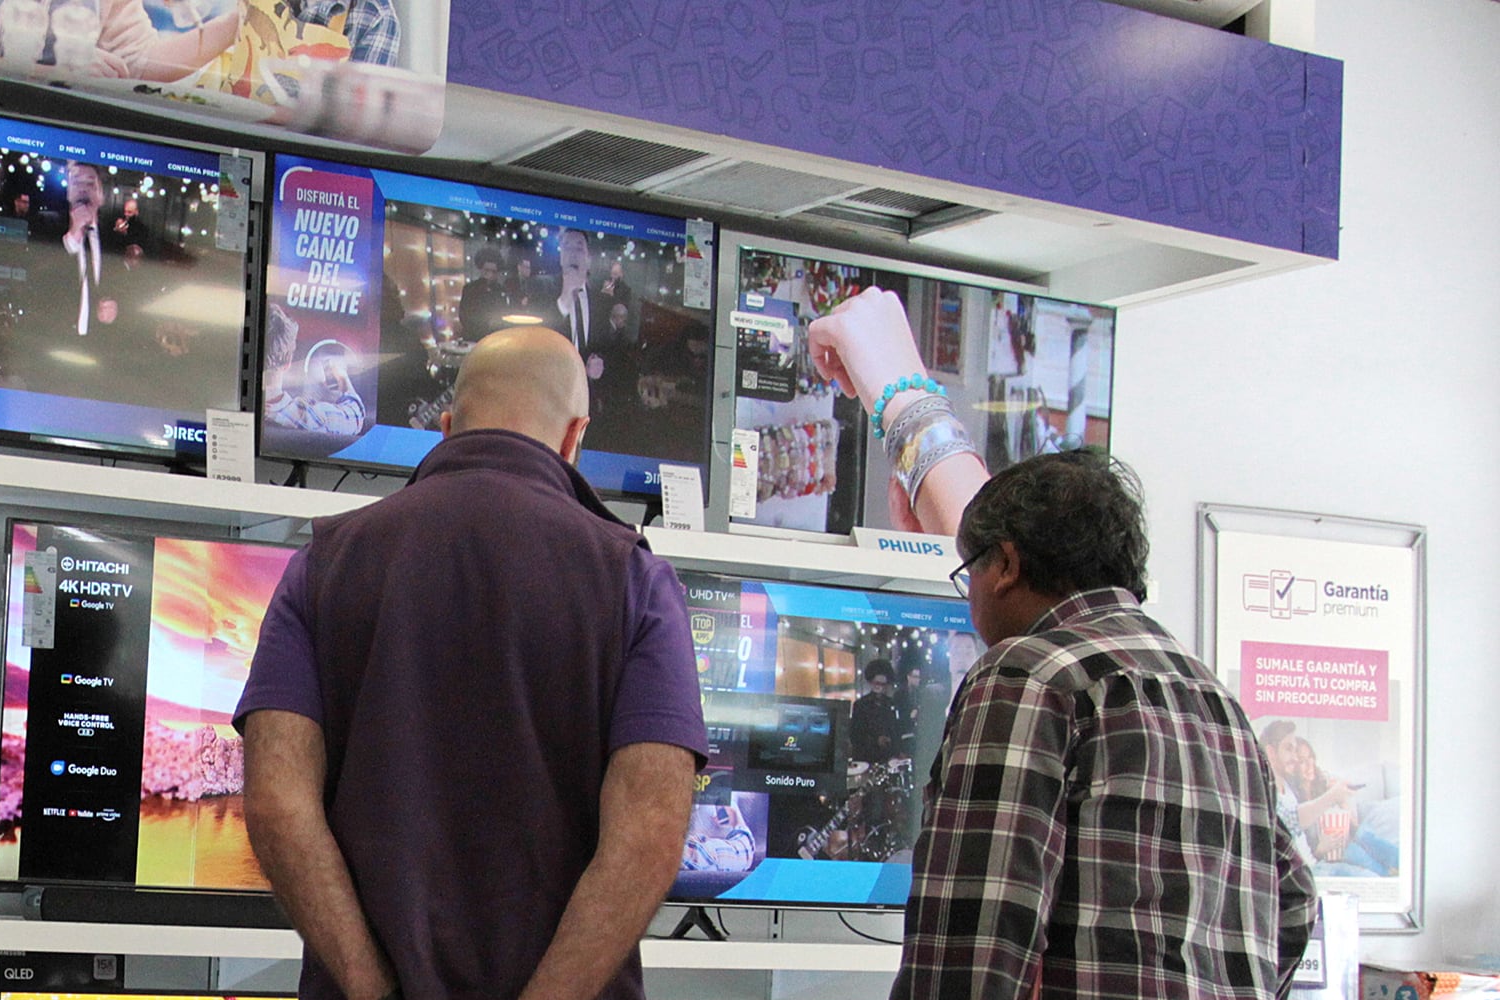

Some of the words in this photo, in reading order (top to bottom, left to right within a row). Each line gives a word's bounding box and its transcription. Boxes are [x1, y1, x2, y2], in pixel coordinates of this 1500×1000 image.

[66, 145, 86, 156] NEWS
[107, 153, 133, 164] SPORTS
[134, 157, 154, 168] FIGHT
[167, 163, 202, 176] CONTRATA
[203, 168, 220, 178] PREM
[296, 187, 345, 209] DISFRUTÁ
[348, 196, 360, 210] EL
[293, 208, 360, 240] NUEVO
[296, 234, 355, 264] CANAL
[307, 260, 340, 287] DEL
[287, 282, 362, 315] CLIENTE
[163, 424, 208, 444] DIRECT
[878, 538, 944, 556] PHILIPS
[75, 559, 130, 575] HITACHI
[58, 579, 79, 594] 4K
[80, 580, 111, 596] HDR
[111, 583, 133, 598] TV
[688, 589, 714, 600] UHD
[714, 590, 728, 601] TV
[1324, 581, 1389, 601] Garantía
[81, 599, 105, 611] Google
[105, 602, 115, 610] TV
[1323, 602, 1379, 618] premium
[695, 618, 712, 629] TOP
[740, 614, 754, 630] EL
[1255, 657, 1304, 672] SUMALE
[1306, 660, 1366, 676] GARANTÍA
[1369, 664, 1378, 677] Y
[74, 675, 102, 688] Google
[103, 677, 114, 687] TV
[1255, 673, 1311, 689] DISFRUTÁ
[1312, 677, 1328, 689] TU
[1330, 678, 1378, 692] COMPRA
[1255, 690, 1275, 703] SIN
[1277, 691, 1378, 709] PREOCUPACIONES
[58, 719, 80, 728] VOICE
[80, 720, 115, 730] CONTROL
[63, 712, 110, 722] HANDS-FREE
[67, 763, 99, 777] Google
[100, 766, 117, 777] Duo
[765, 774, 795, 787] Sonido
[796, 776, 816, 788] Puro
[43, 807, 66, 816] NETFLIX
[3, 967, 34, 980] QLED
